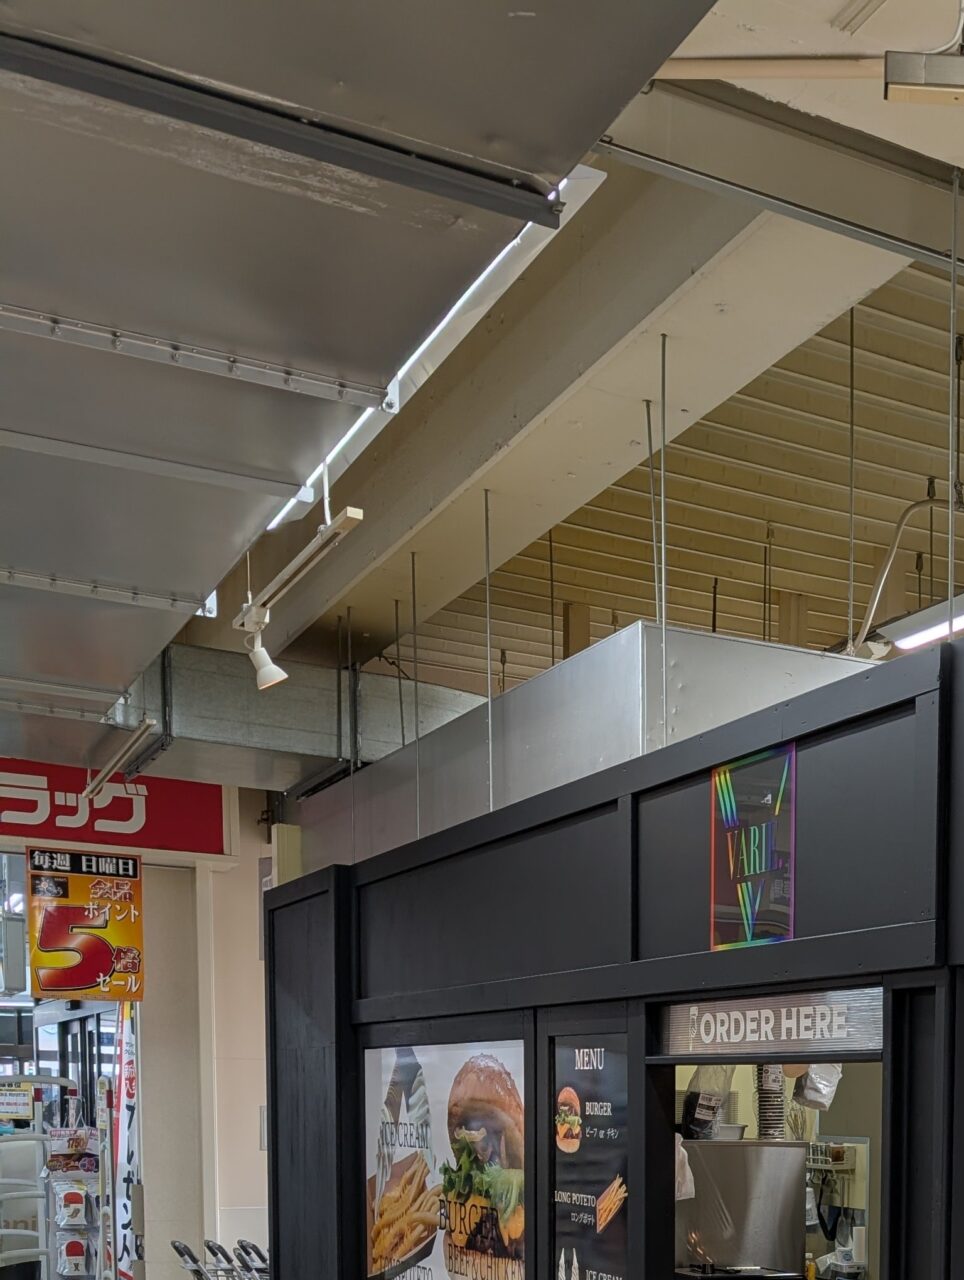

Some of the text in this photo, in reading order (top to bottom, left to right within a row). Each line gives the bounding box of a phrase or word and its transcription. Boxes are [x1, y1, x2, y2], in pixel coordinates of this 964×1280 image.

[33, 851, 134, 876] 毎週 日曜日
[89, 879, 133, 902] 全品
[84, 901, 139, 923] ポイント
[35, 904, 115, 991] 5
[112, 946, 140, 973] 倍
[96, 973, 141, 992] セール
[700, 1004, 848, 1043] ORDER HERE
[575, 1048, 605, 1070] MENU
[585, 1101, 612, 1116] BURGER
[381, 1121, 429, 1149] ICE CREAM
[585, 1126, 597, 1138] ビーフ
[606, 1127, 619, 1139] チキン
[554, 1190, 596, 1208] LONG POTETO
[439, 1199, 500, 1240] BURGER
[571, 1212, 595, 1226] ロングポテト
